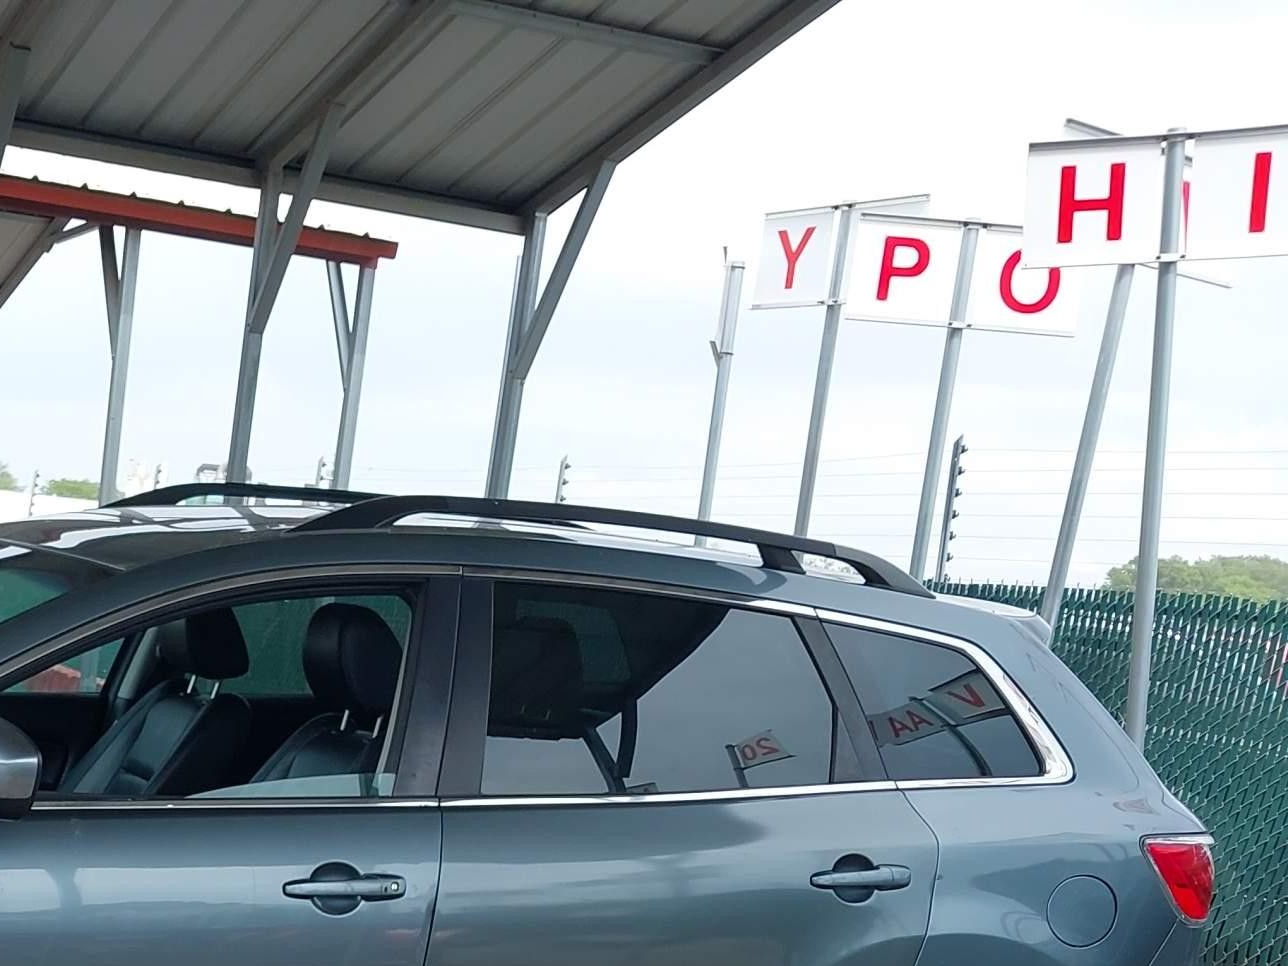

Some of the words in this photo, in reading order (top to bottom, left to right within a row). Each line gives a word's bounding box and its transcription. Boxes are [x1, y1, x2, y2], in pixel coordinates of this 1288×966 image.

[1056, 161, 1127, 245] H
[777, 226, 816, 290] Y
[875, 235, 932, 302] P
